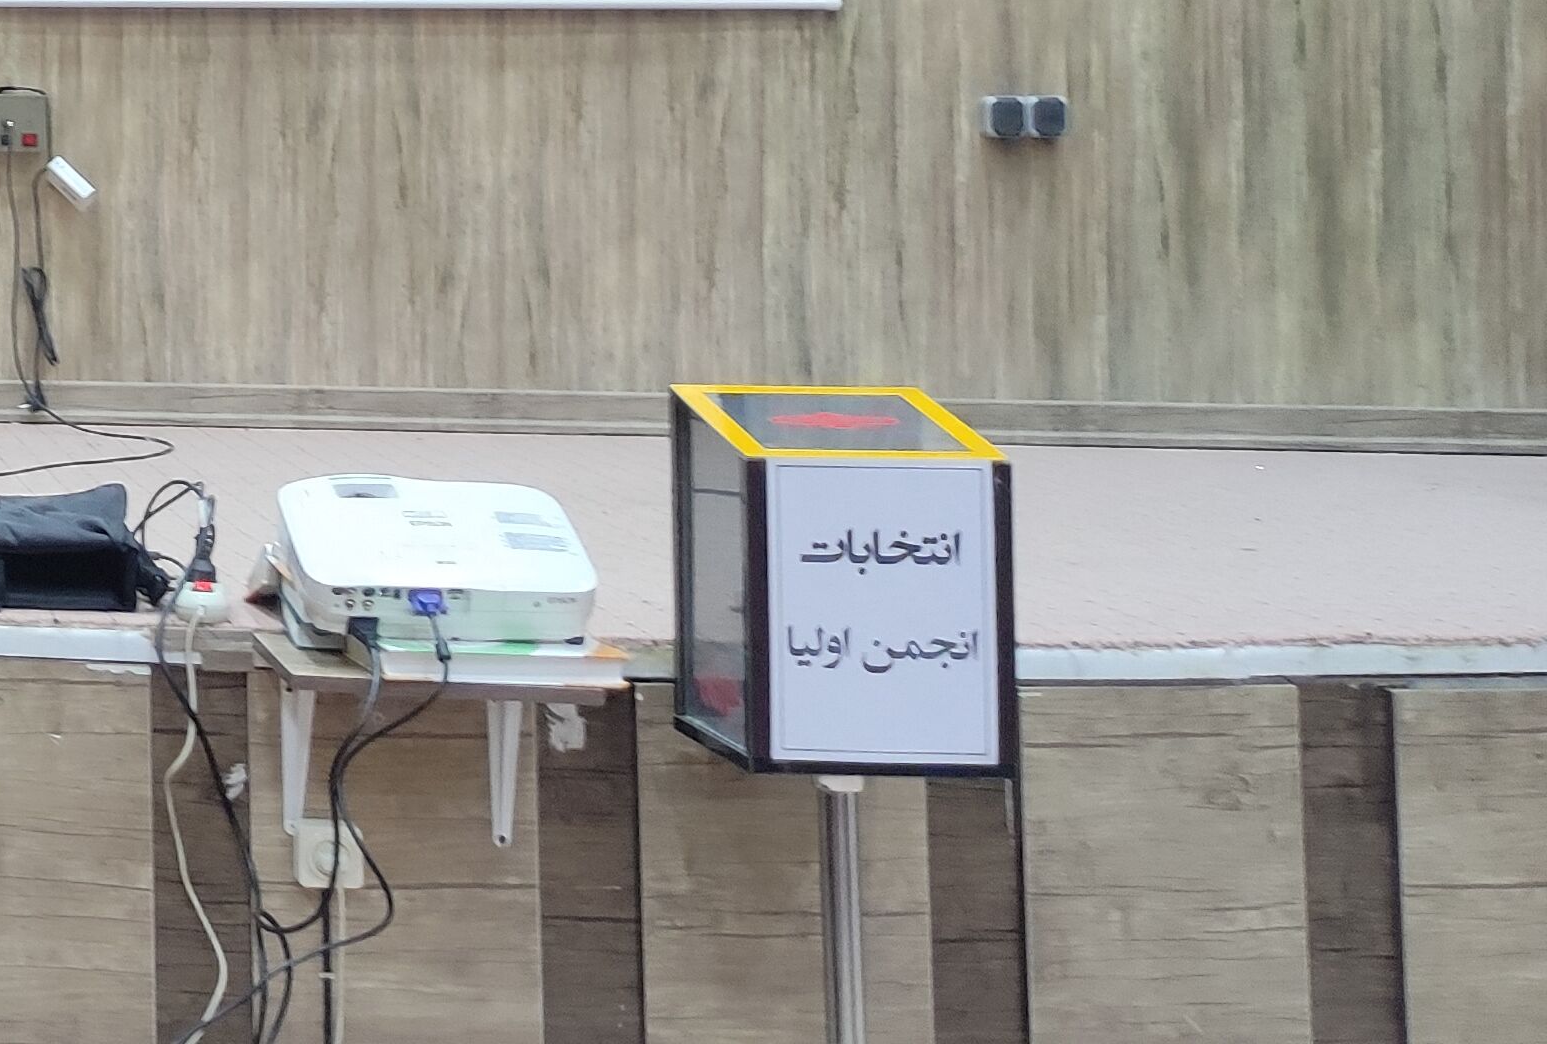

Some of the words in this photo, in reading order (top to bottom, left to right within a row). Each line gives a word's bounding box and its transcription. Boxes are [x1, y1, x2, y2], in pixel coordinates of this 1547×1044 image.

[799, 528, 961, 575] انتخابات
[787, 624, 851, 669] اولیا
[862, 630, 979, 674] انجمن
